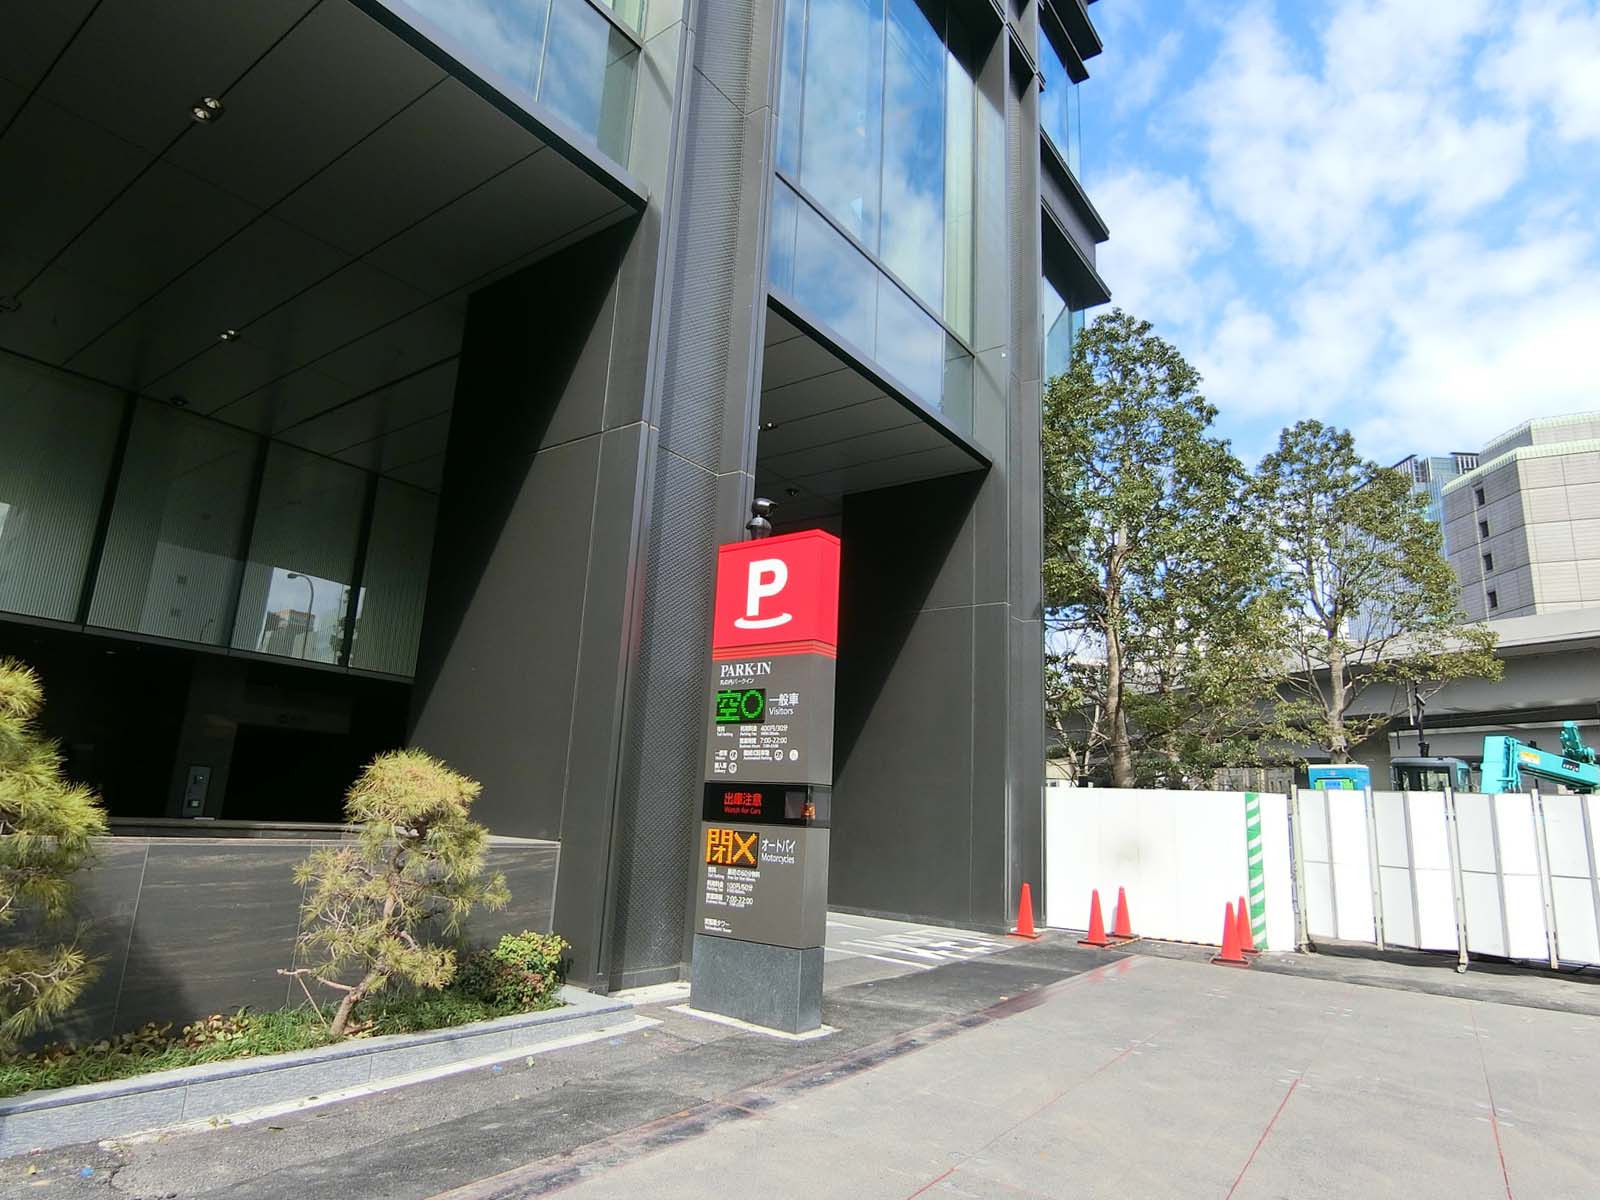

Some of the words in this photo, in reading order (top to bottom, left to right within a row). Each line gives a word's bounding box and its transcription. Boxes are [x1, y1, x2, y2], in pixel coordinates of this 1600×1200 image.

[746, 558, 788, 617] P
[720, 662, 772, 678] PARK-IN
[768, 692, 800, 706] 一般車
[768, 707, 794, 716] Visitors
[761, 838, 797, 853] オートバイ
[761, 853, 796, 864] Motorcycles
